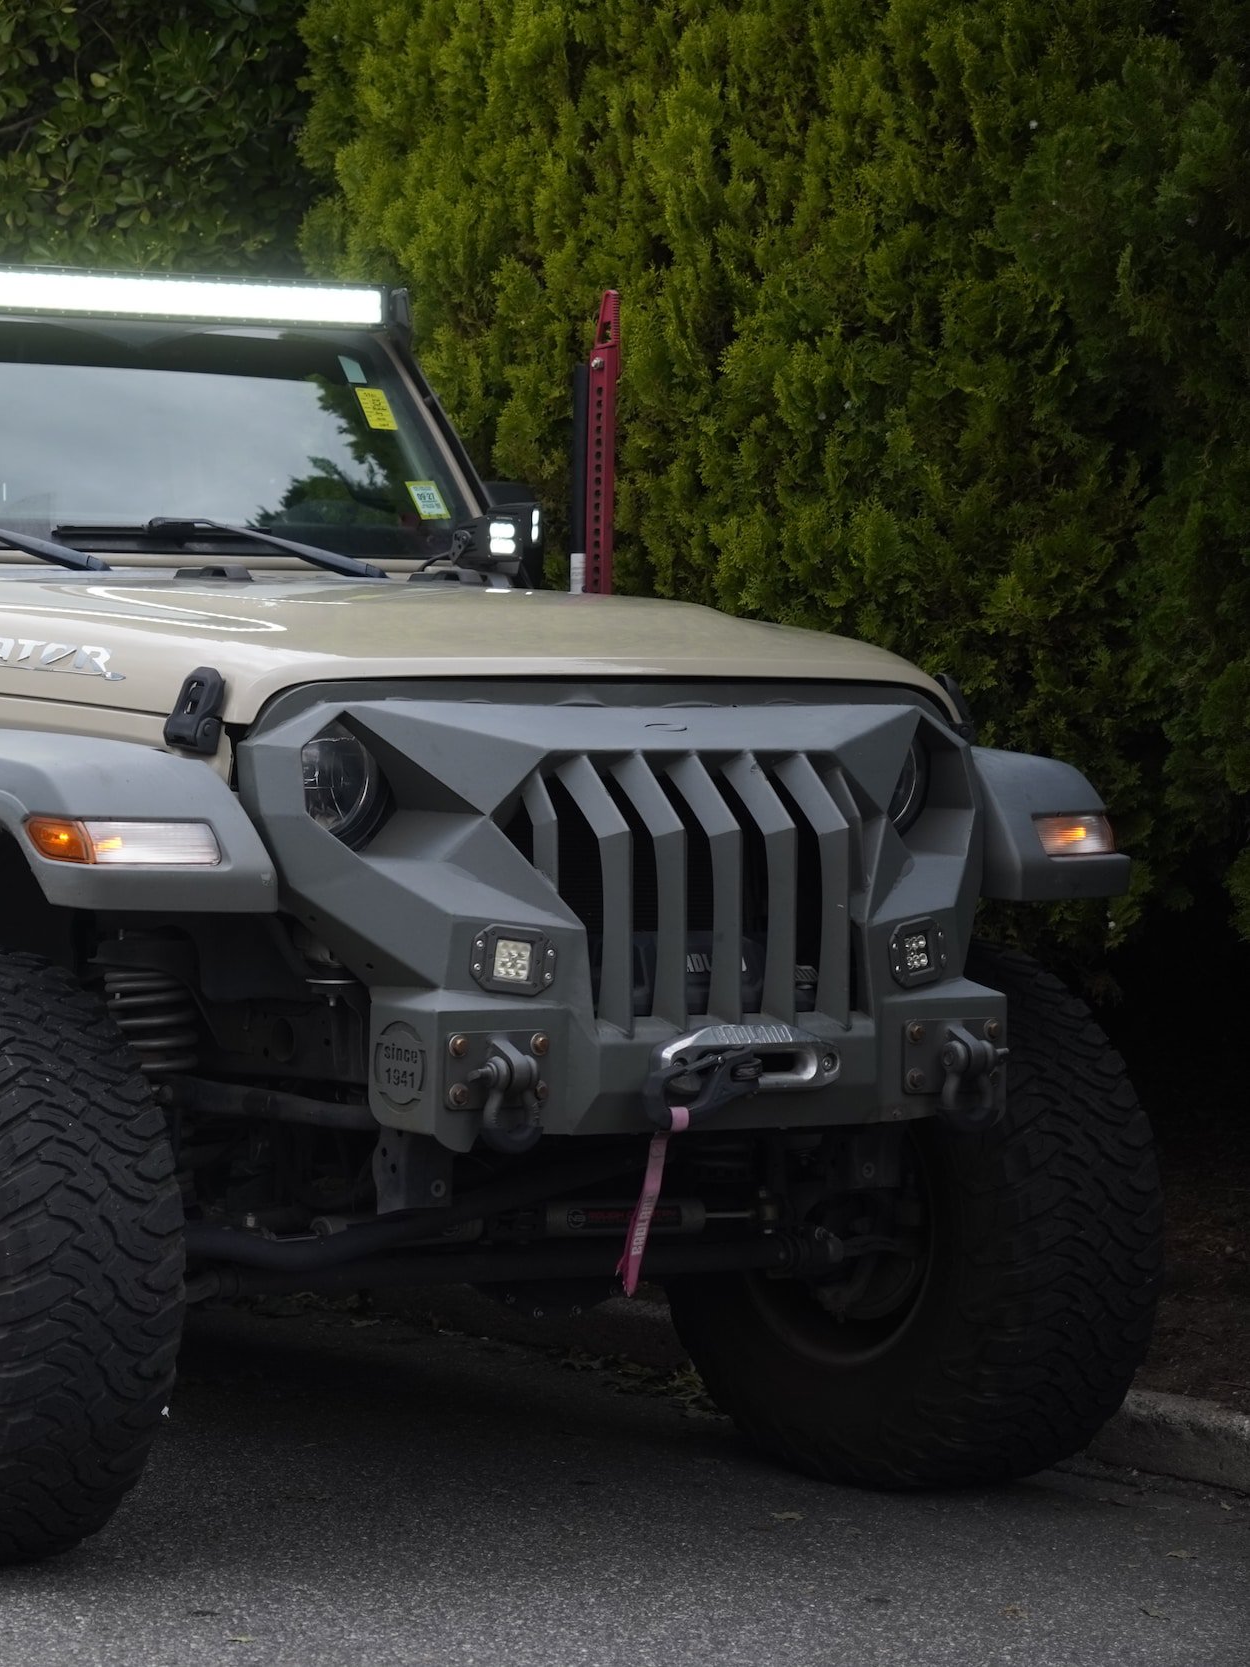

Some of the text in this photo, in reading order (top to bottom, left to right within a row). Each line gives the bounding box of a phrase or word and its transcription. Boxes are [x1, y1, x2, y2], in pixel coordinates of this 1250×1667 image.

[384, 1043, 418, 1064] since
[385, 1067, 415, 1088] 1941
[631, 1194, 656, 1256] BADLAND
